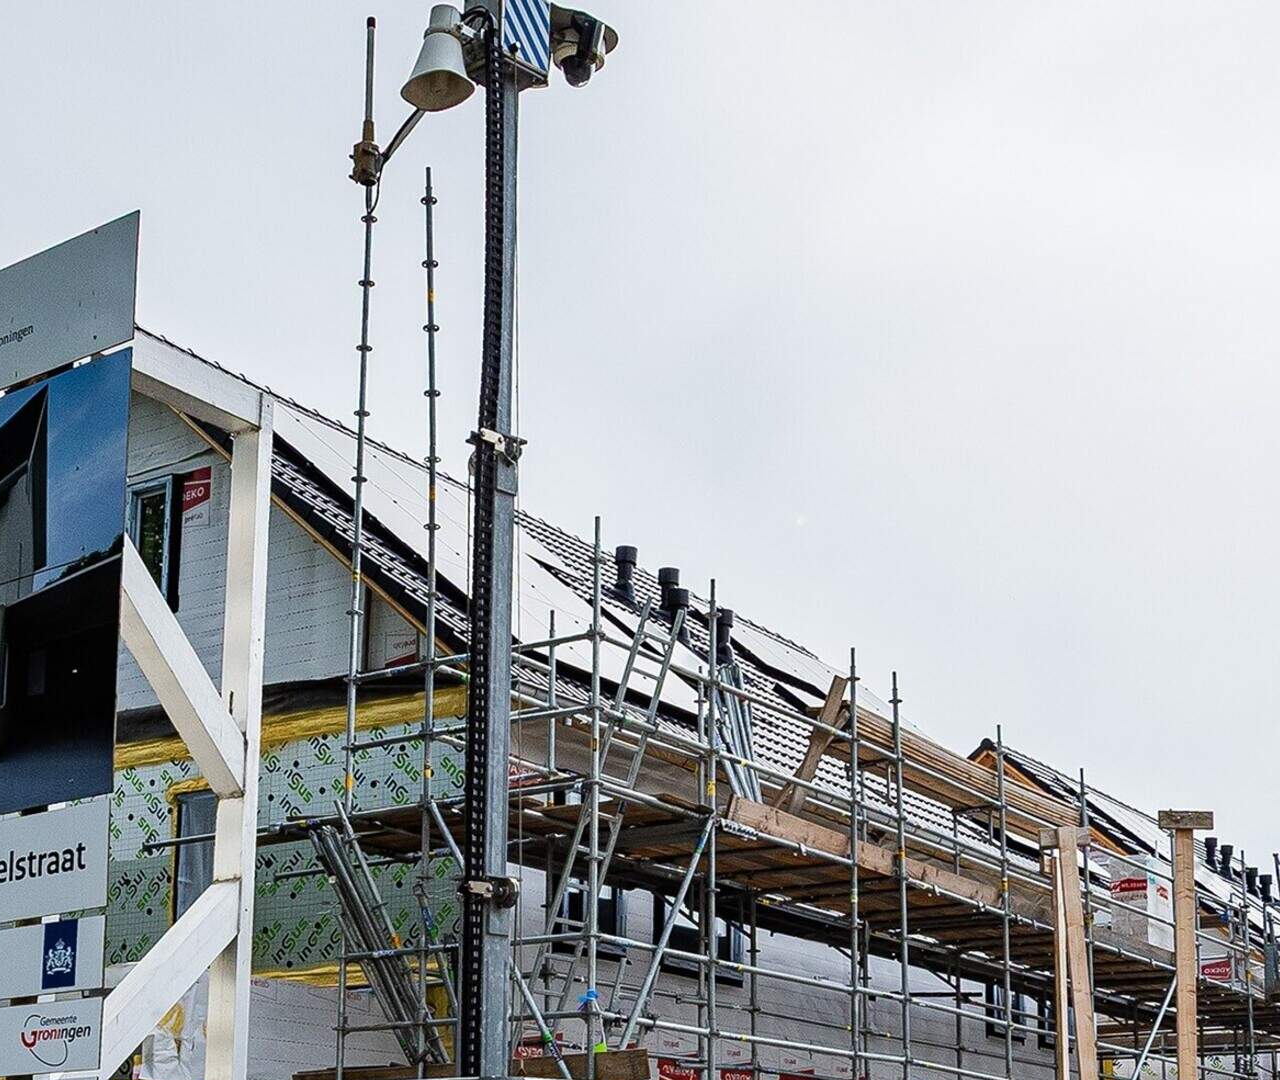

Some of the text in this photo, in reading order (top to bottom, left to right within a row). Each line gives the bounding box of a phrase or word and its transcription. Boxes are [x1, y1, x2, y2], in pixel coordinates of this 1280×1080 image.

[271, 917, 310, 965] inSus
[40, 1014, 77, 1028] Gemeente
[21, 1024, 91, 1050] Groningen
